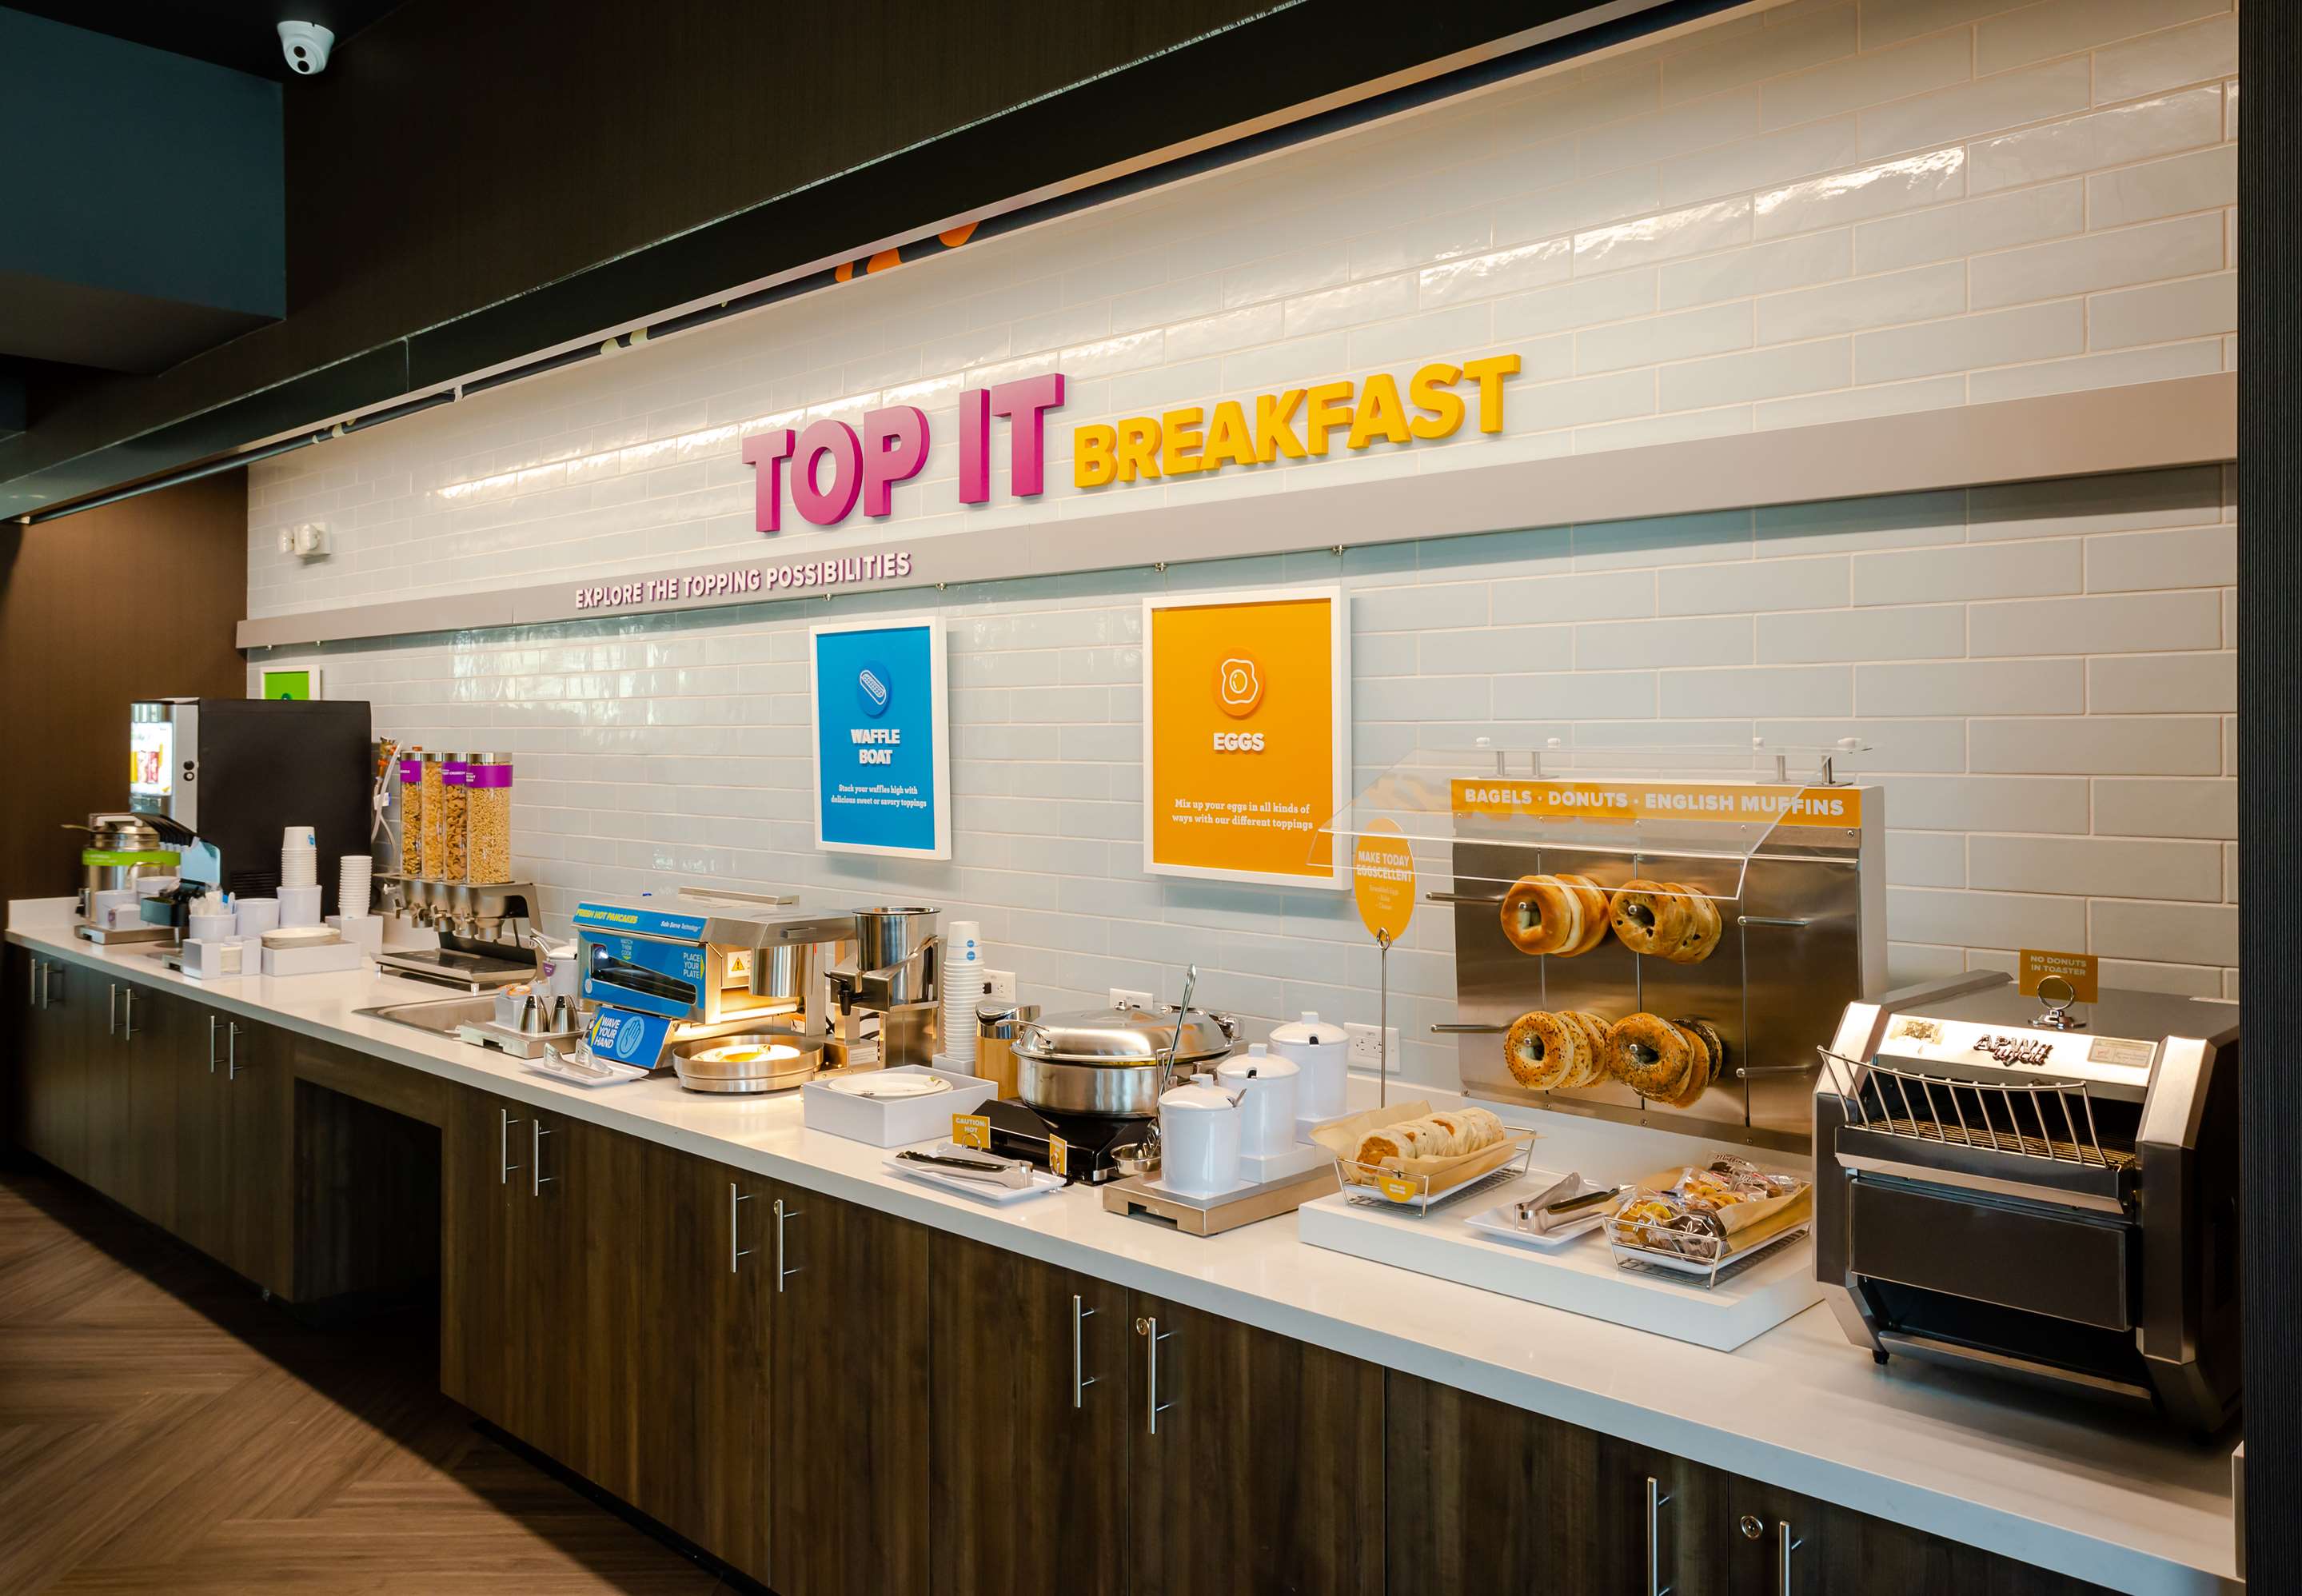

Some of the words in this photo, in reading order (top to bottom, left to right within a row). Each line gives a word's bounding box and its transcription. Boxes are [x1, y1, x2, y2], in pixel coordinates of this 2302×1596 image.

[742, 405, 930, 533] TOP
[959, 373, 1064, 504] IT
[1075, 353, 1521, 489] BREAKFAST
[576, 582, 643, 608] EXPLORE
[647, 578, 679, 600] THE
[683, 569, 761, 597] TOPPING
[767, 552, 912, 589] POSSIBILITIES
[851, 729, 900, 744] WAFFLE
[1213, 732, 1265, 752] EGGS
[859, 749, 893, 765] BOAT
[839, 784, 854, 792] Stack
[869, 784, 890, 793] waffles
[891, 785, 904, 796] high
[831, 795, 856, 804] delicious
[881, 799, 900, 808] savory
[901, 799, 927, 808] toppings
[1175, 800, 1191, 808] Mix
[1192, 802, 1203, 811] up
[1205, 802, 1225, 811] your
[1227, 804, 1247, 812] eggs
[1248, 802, 1258, 812] in
[1259, 802, 1271, 812] all
[1273, 803, 1299, 813] kinds
[1300, 804, 1311, 814] of
[1465, 788, 1531, 804] BAGELS
[1548, 791, 1628, 808] DONUTS
[1645, 793, 1733, 811] ENGLISH
[1741, 796, 1844, 816] MUFFINS
[1172, 814, 1193, 824] ways
[1195, 814, 1213, 823] with
[1232, 816, 1271, 827] different
[1272, 819, 1313, 832] toppings
[1358, 851, 1381, 864] MAKE
[1382, 853, 1410, 867] TODAY
[1356, 864, 1413, 883] EGGSCELLENT
[576, 908, 594, 918] FRESH
[594, 911, 608, 920] HOT
[606, 912, 638, 924] PANCAKES
[684, 952, 700, 962] PLACE
[2047, 957, 2086, 967] DONUTS
[684, 960, 700, 970] YOUR
[2043, 965, 2086, 976] TOASTER
[684, 969, 700, 979] PLATE
[601, 1017, 620, 1029] WAVE
[598, 1027, 617, 1039] YOUR
[594, 1035, 614, 1048] HAND
